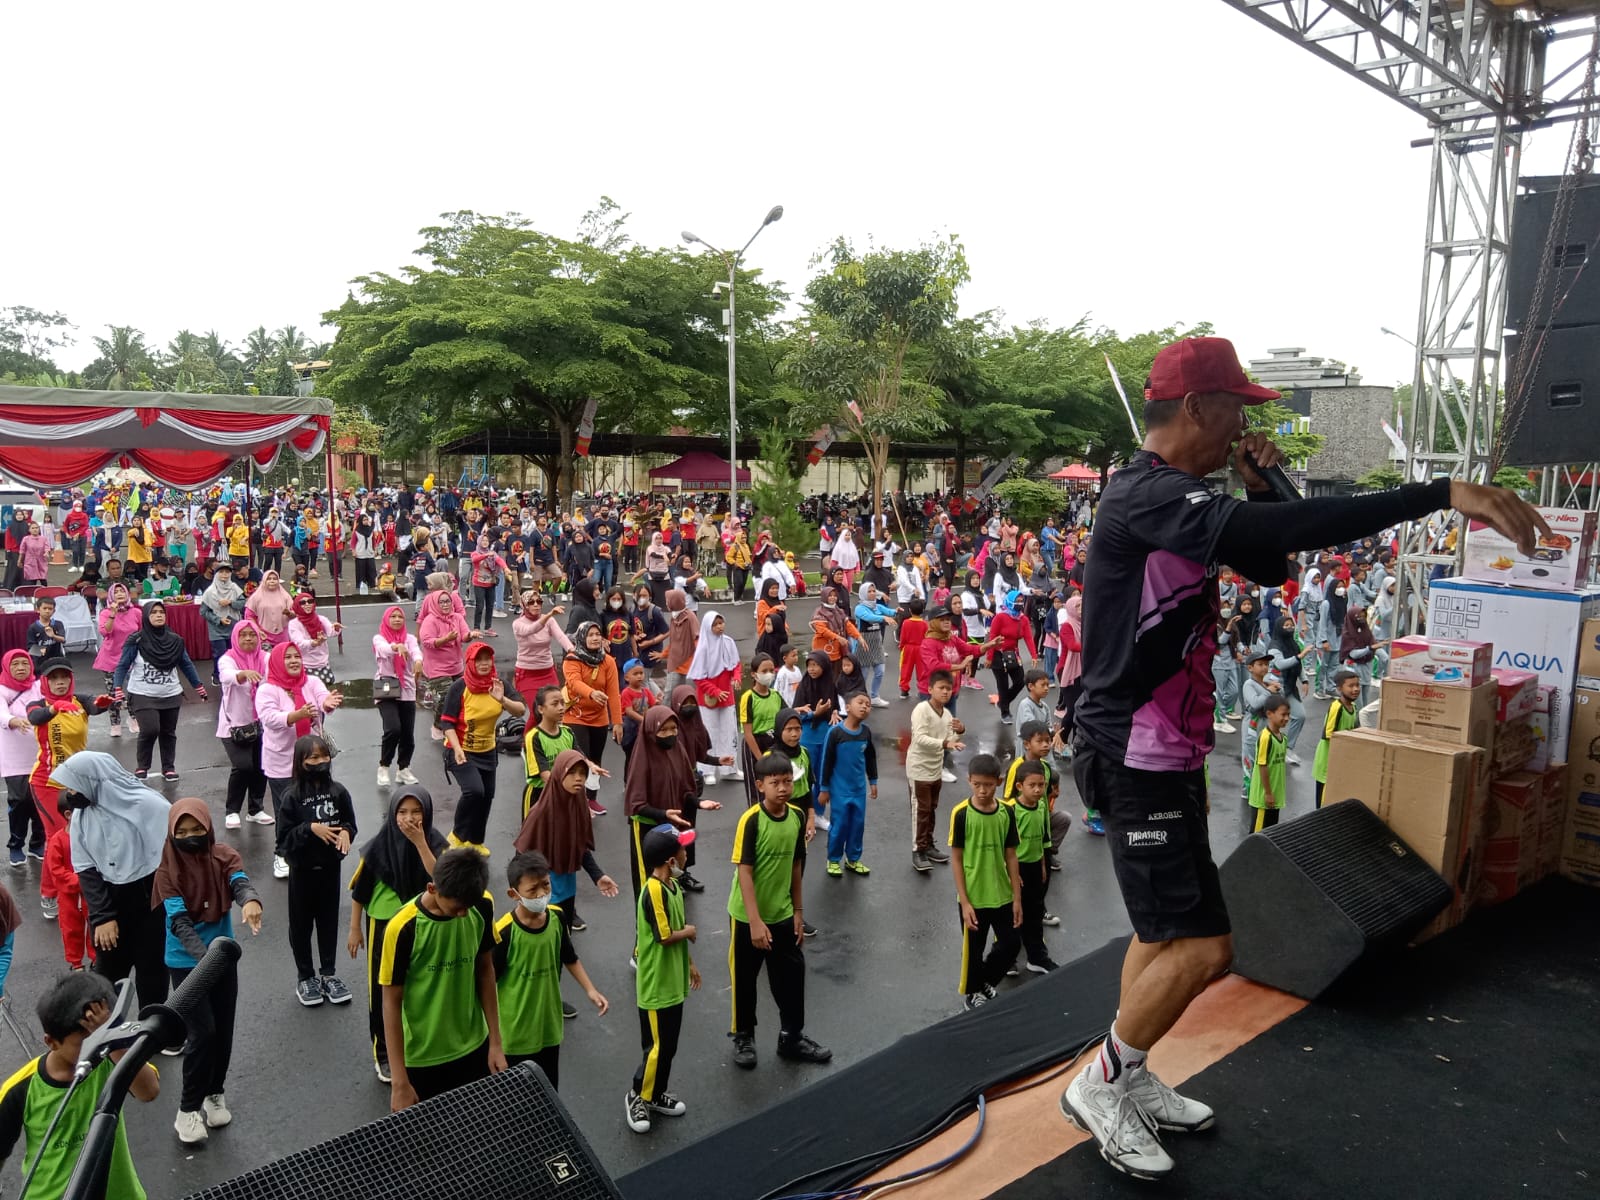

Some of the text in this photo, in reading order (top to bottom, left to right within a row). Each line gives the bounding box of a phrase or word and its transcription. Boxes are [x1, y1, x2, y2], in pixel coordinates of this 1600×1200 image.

[1495, 651, 1564, 673] AQUA
[1576, 694, 1589, 705] 19
[1148, 810, 1183, 821] AEROBIC
[1126, 830, 1168, 846] THRASHER
